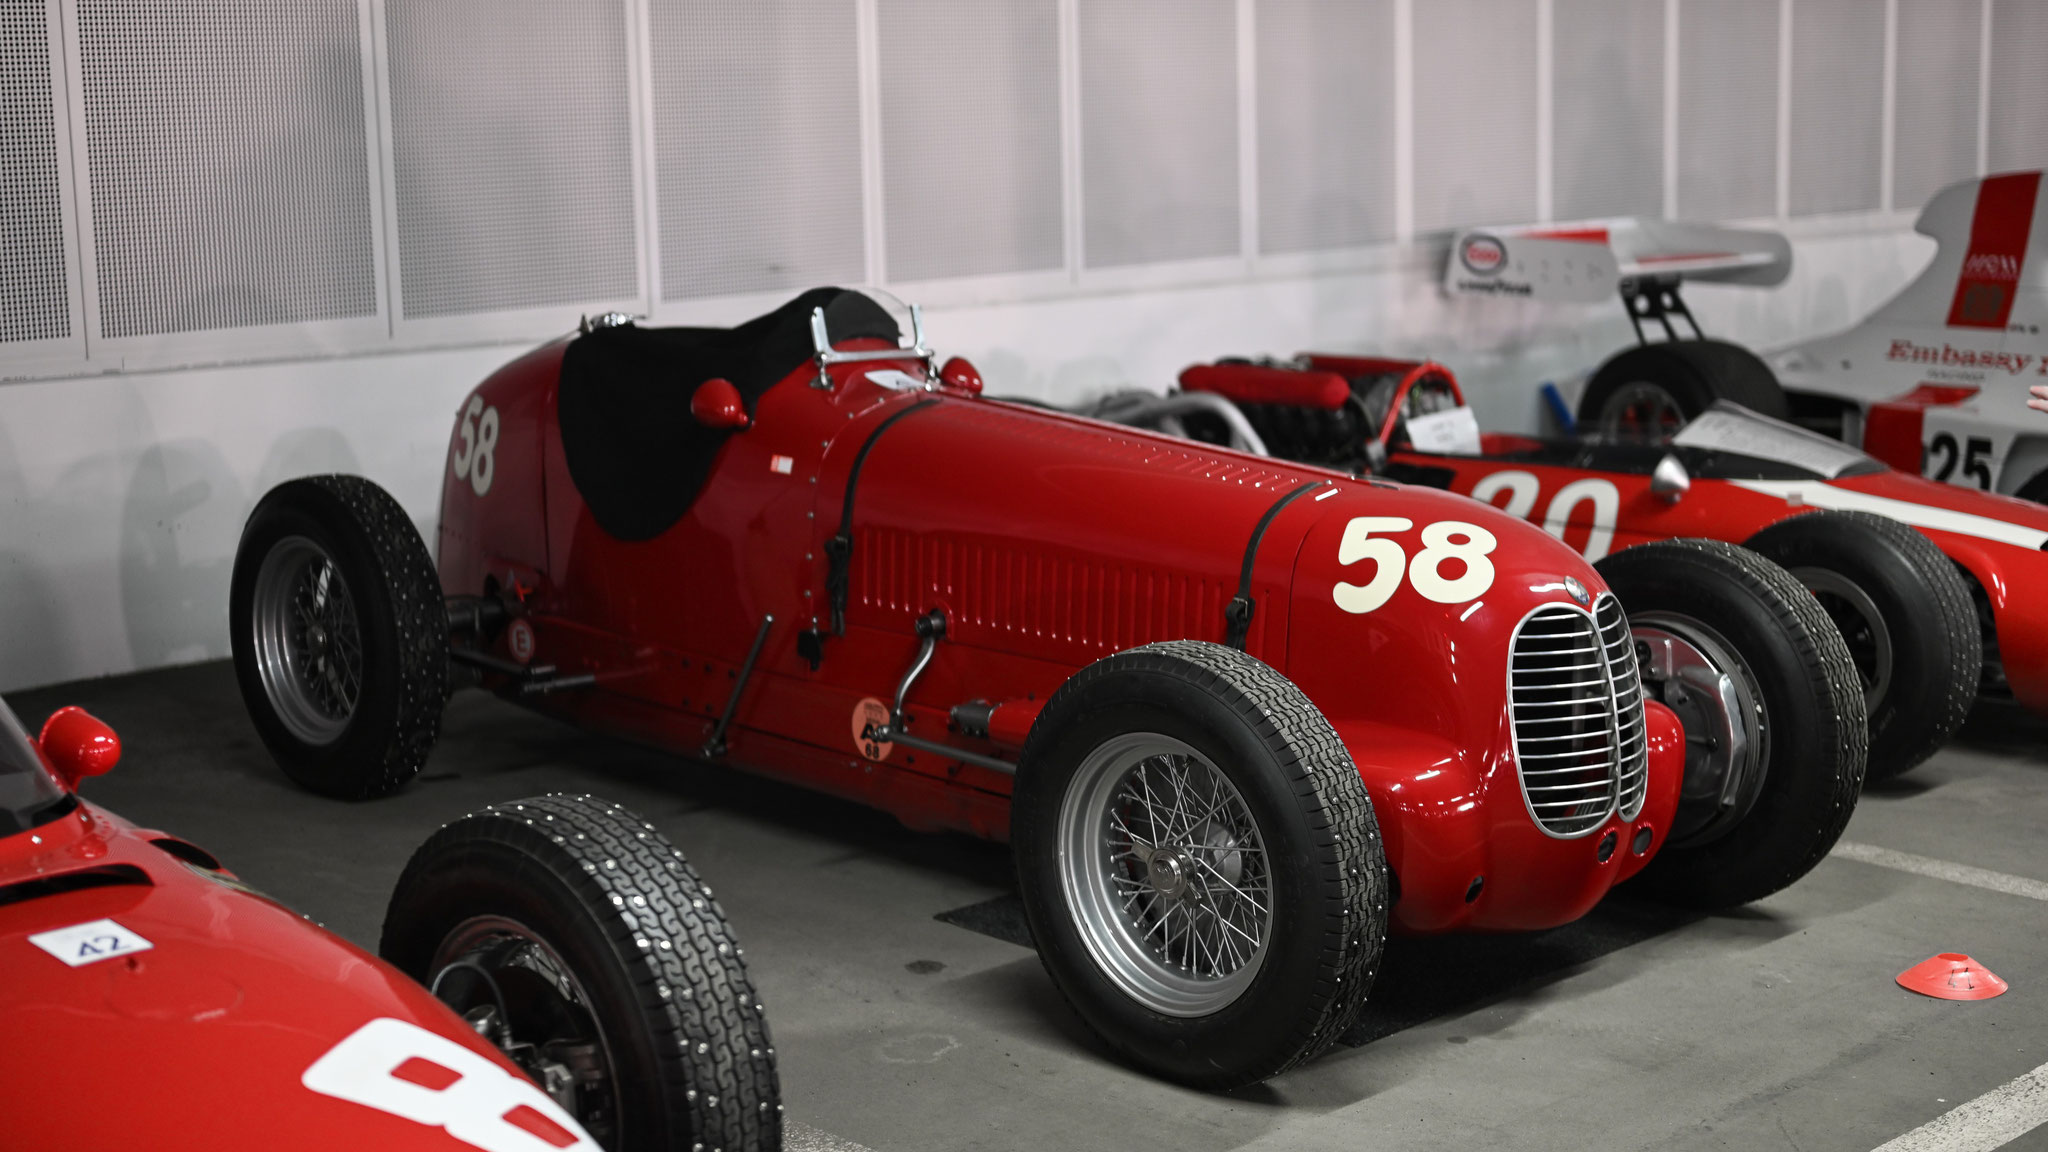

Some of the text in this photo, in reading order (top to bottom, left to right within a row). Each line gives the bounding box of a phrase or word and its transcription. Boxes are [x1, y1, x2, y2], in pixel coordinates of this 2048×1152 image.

[1886, 339, 2033, 375] Embassy
[454, 393, 499, 496] 58
[1929, 431, 1992, 493] 25
[1332, 516, 1498, 614] 58
[301, 1017, 604, 1152] 8
